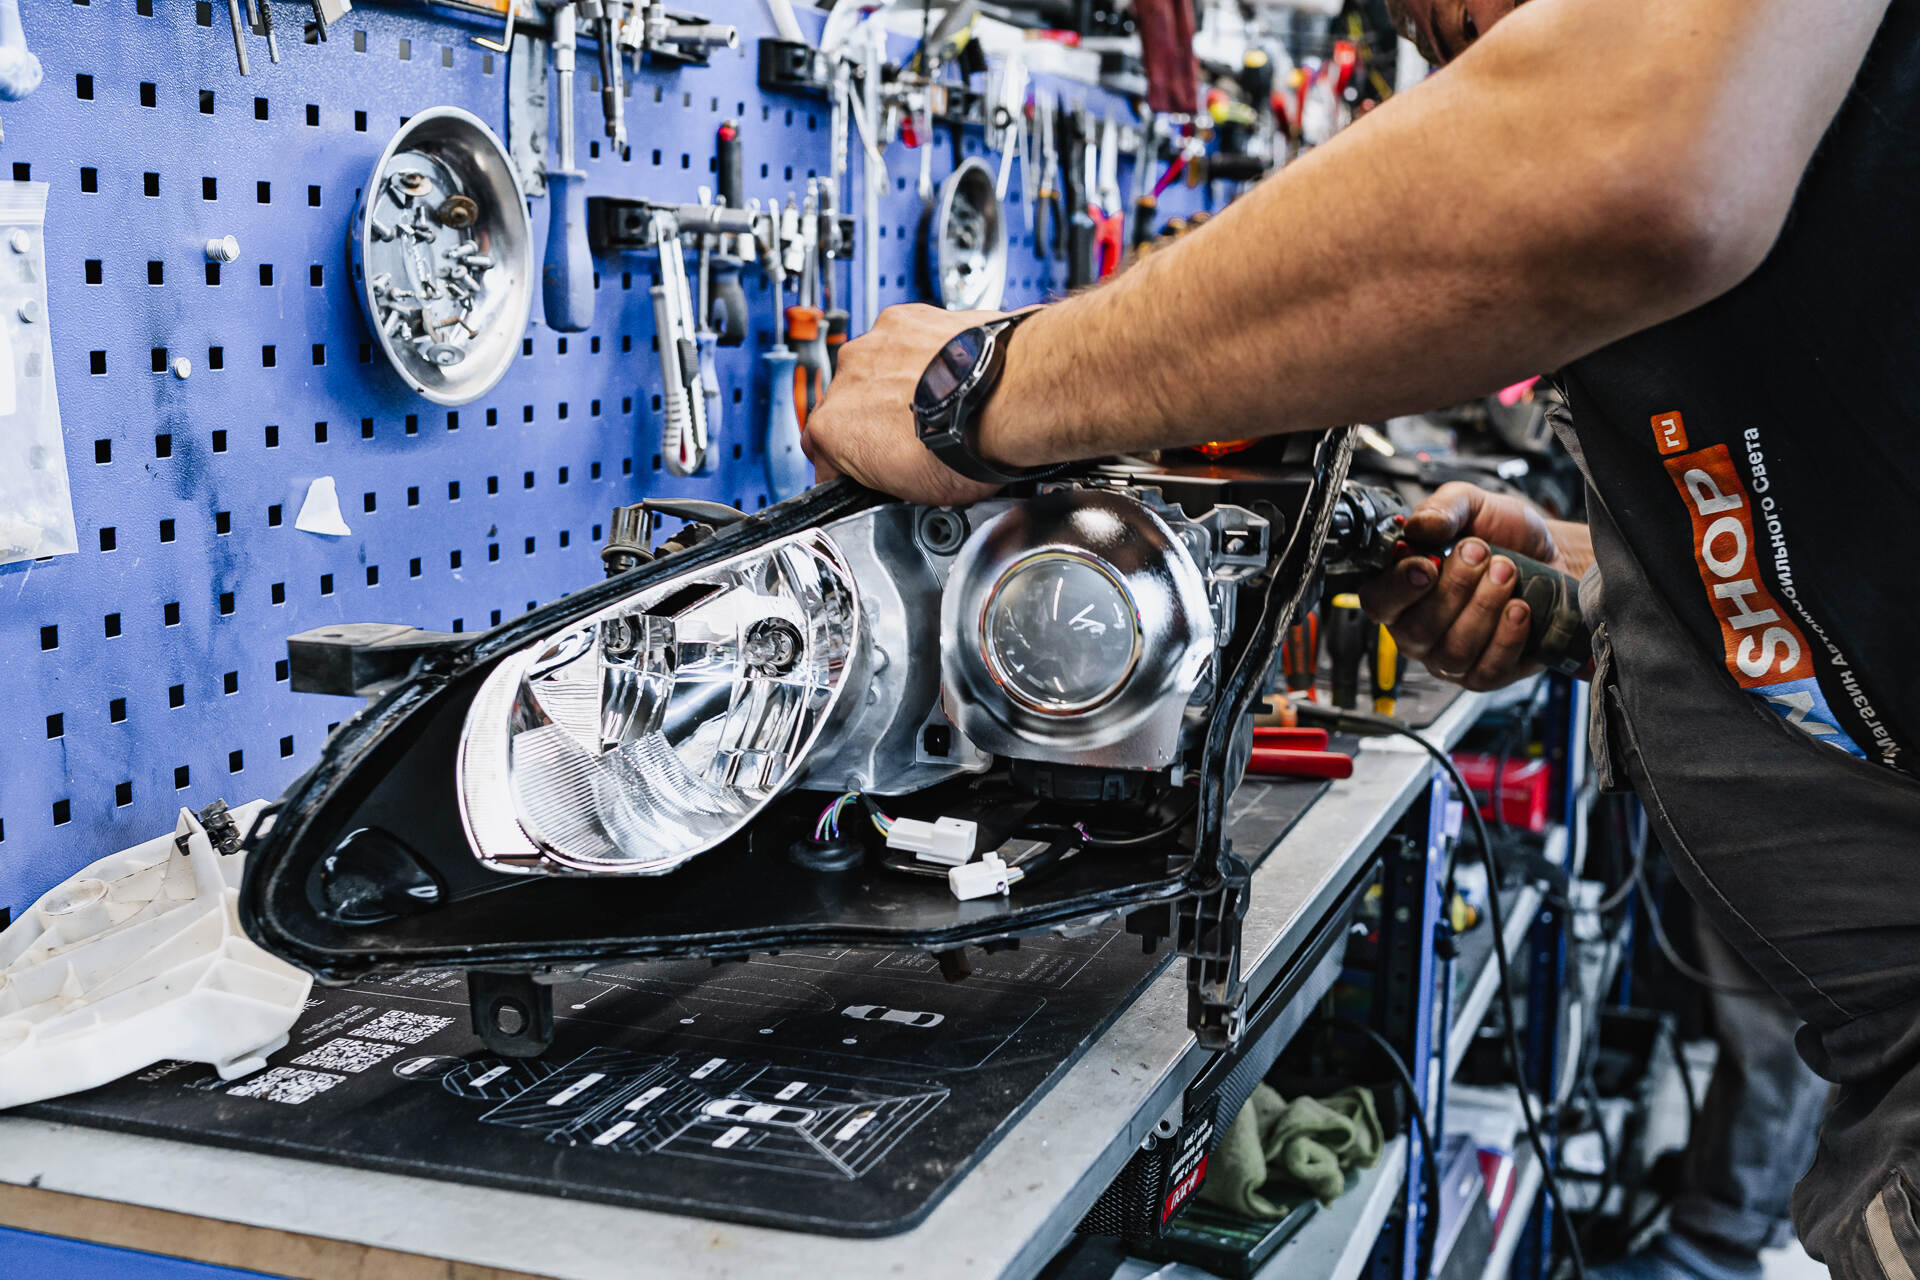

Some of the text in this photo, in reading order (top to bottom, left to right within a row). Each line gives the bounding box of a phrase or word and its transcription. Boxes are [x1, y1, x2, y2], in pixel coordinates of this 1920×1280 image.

[1661, 419, 1681, 448] ru
[1743, 427, 1770, 494] Света
[1684, 468, 1801, 678] SHOP
[1840, 670, 1902, 758] Магазин
